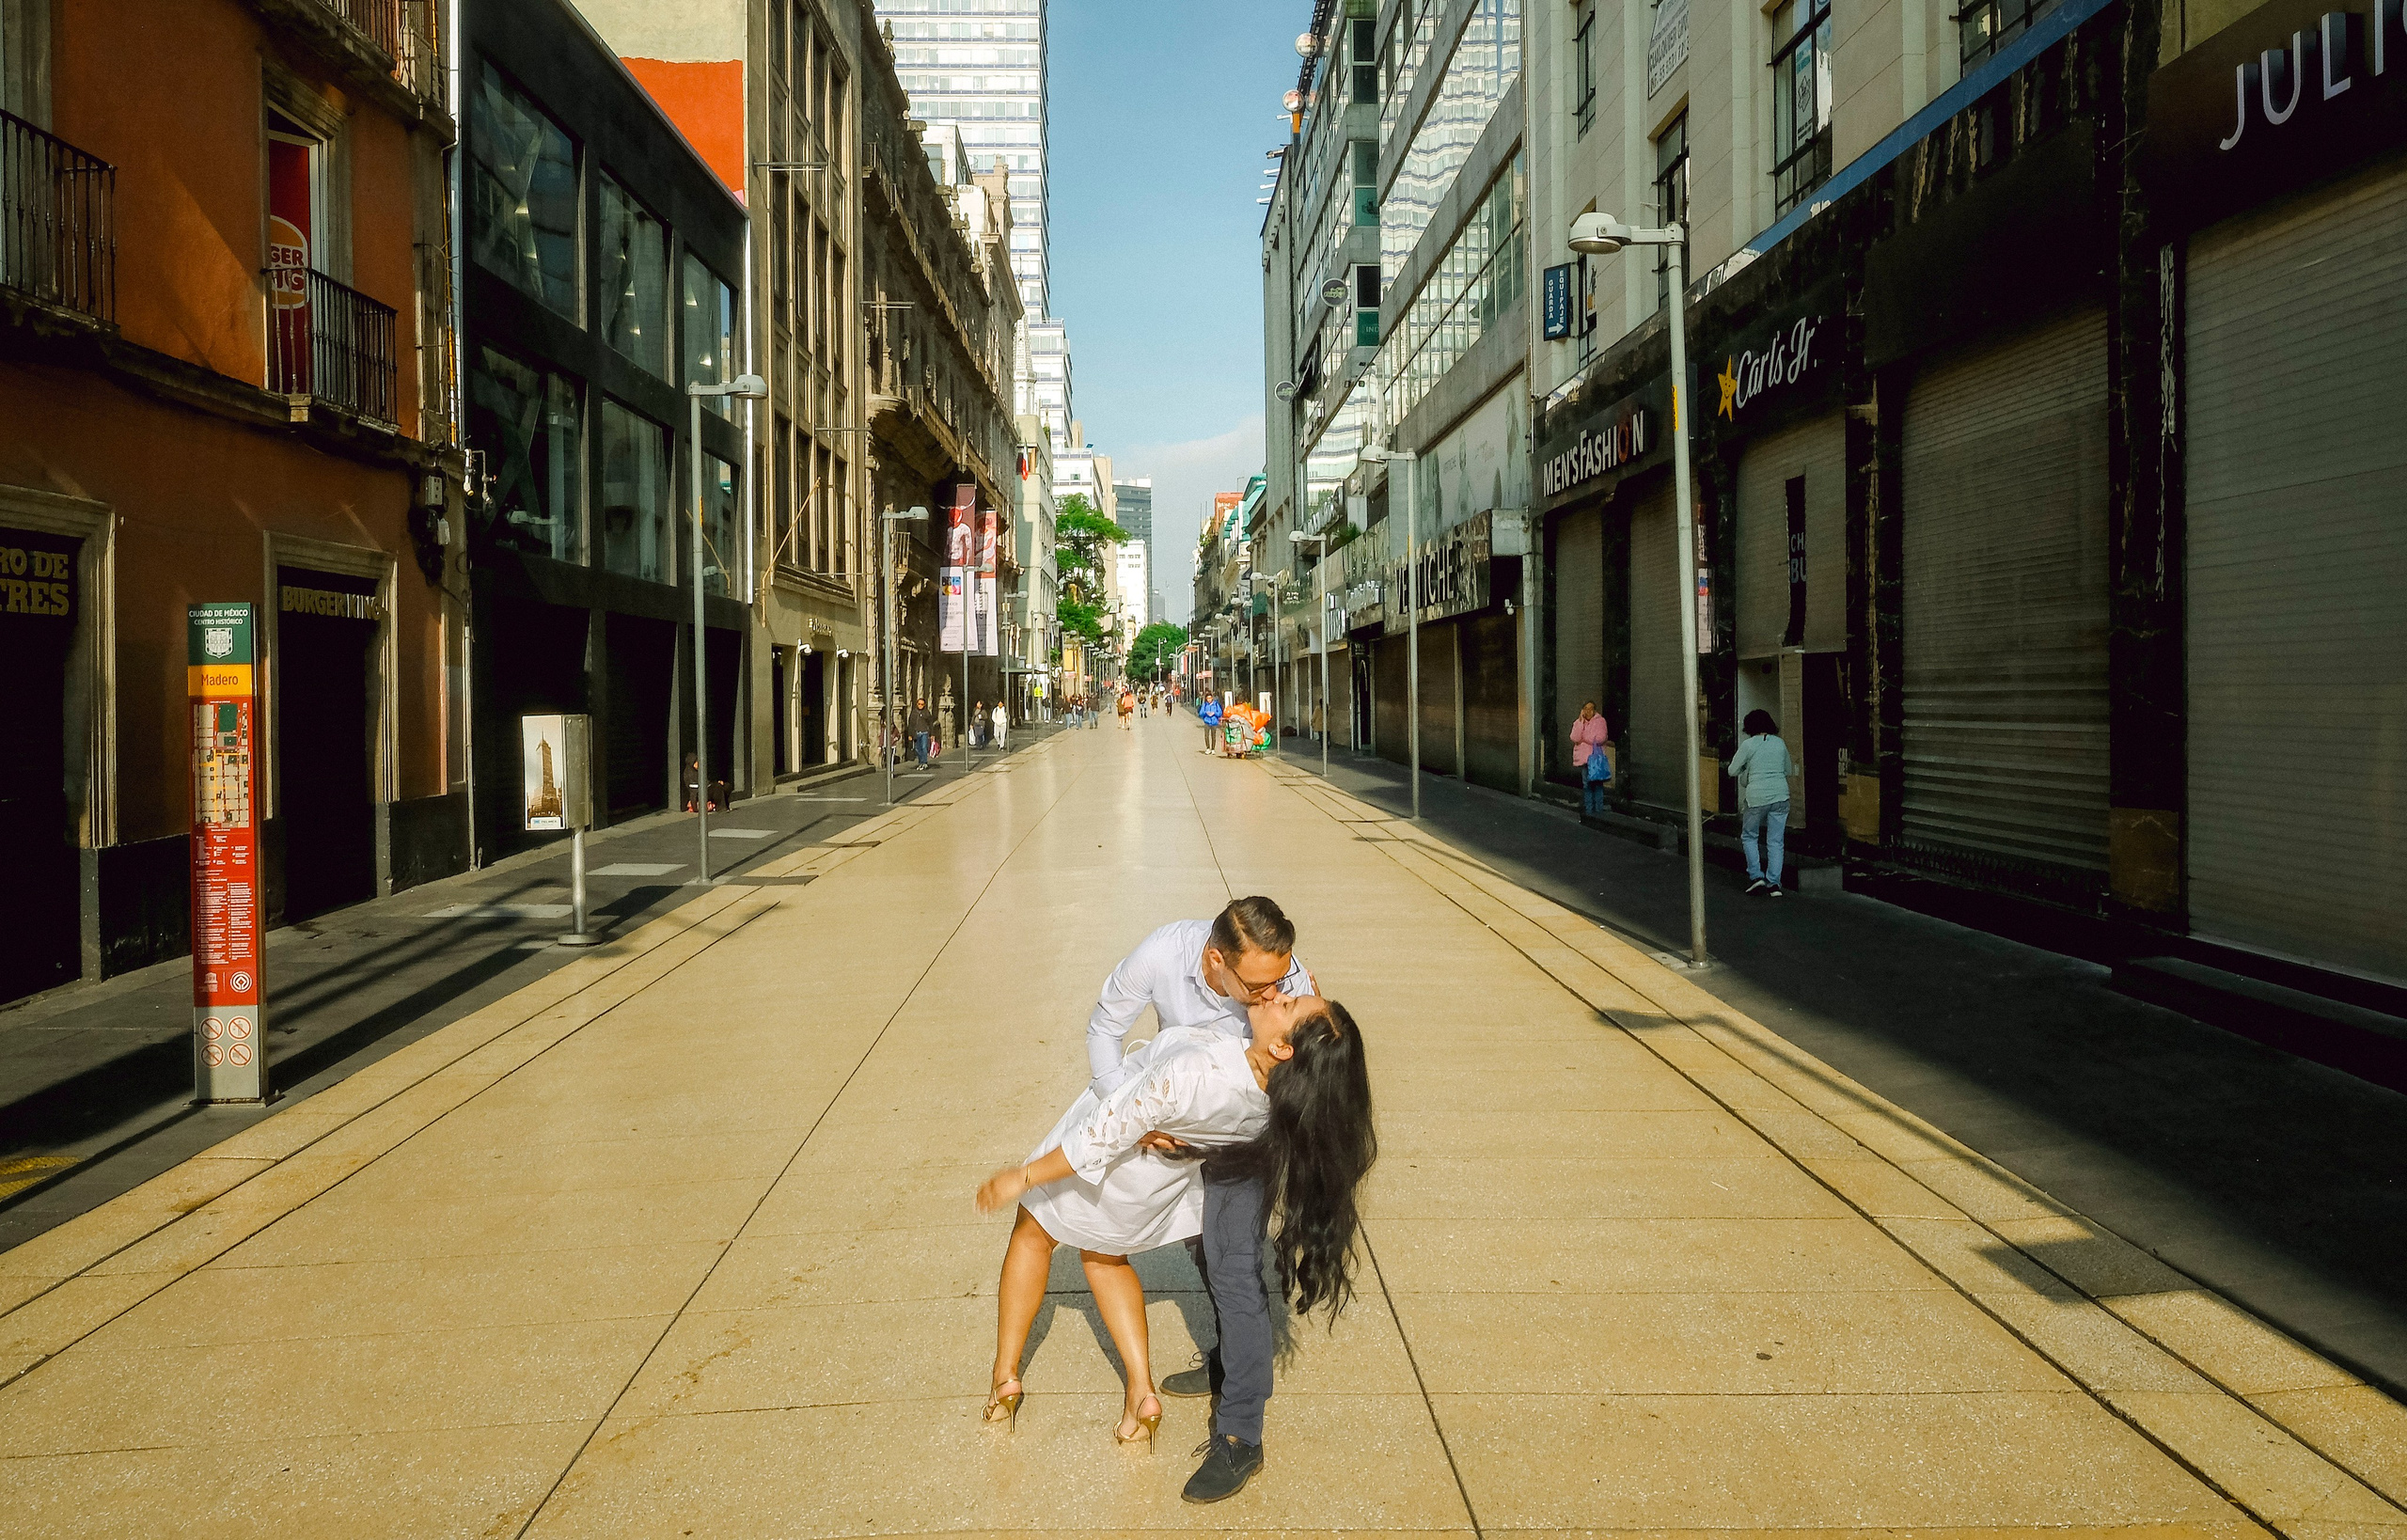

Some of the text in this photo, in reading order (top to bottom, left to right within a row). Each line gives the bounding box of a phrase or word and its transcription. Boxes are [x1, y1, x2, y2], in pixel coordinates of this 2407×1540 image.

[2219, 0, 2407, 150] JULI
[1735, 330, 1786, 409] Carl's
[1543, 409, 1644, 498] MEN'S FASHION
[1790, 531, 1805, 553] CH
[34, 550, 69, 580] DE
[1393, 542, 1455, 616] VETICHE
[189, 609, 213, 618] CIUDAD
[224, 607, 248, 617] MÉXICO
[282, 585, 345, 618] BURGER
[215, 617, 244, 625] HISTÓRICO
[201, 674, 239, 686] Madero
